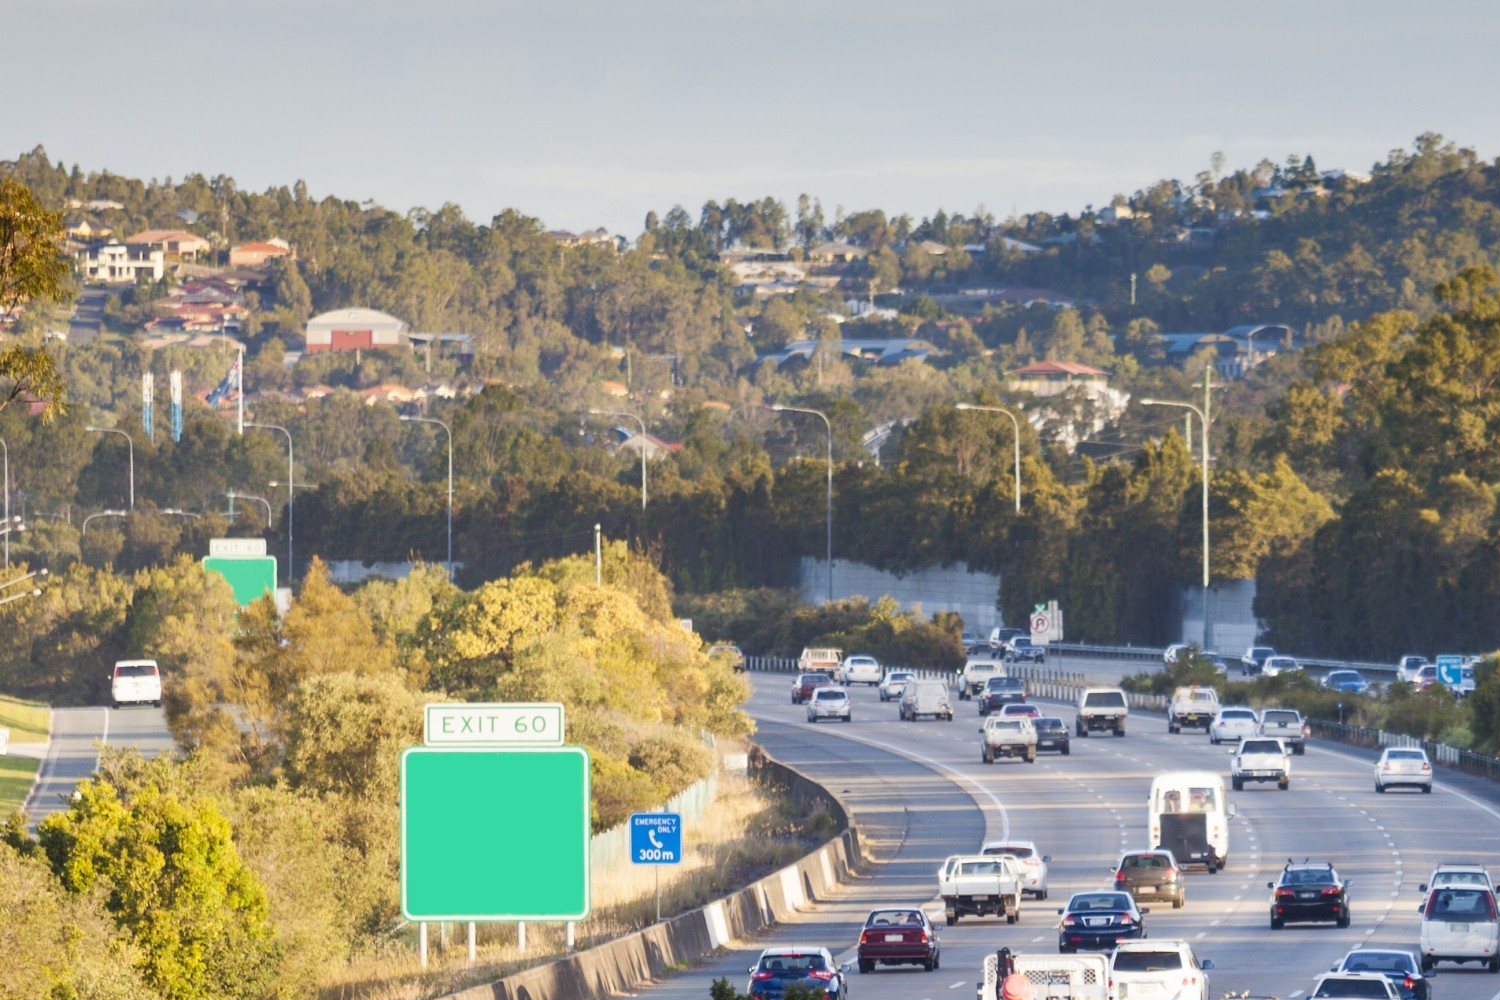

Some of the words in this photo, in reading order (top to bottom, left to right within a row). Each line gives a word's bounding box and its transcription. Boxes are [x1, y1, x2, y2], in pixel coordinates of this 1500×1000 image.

[442, 716, 499, 733] EXIT
[514, 716, 546, 733] 60
[639, 849, 674, 860] 300m
